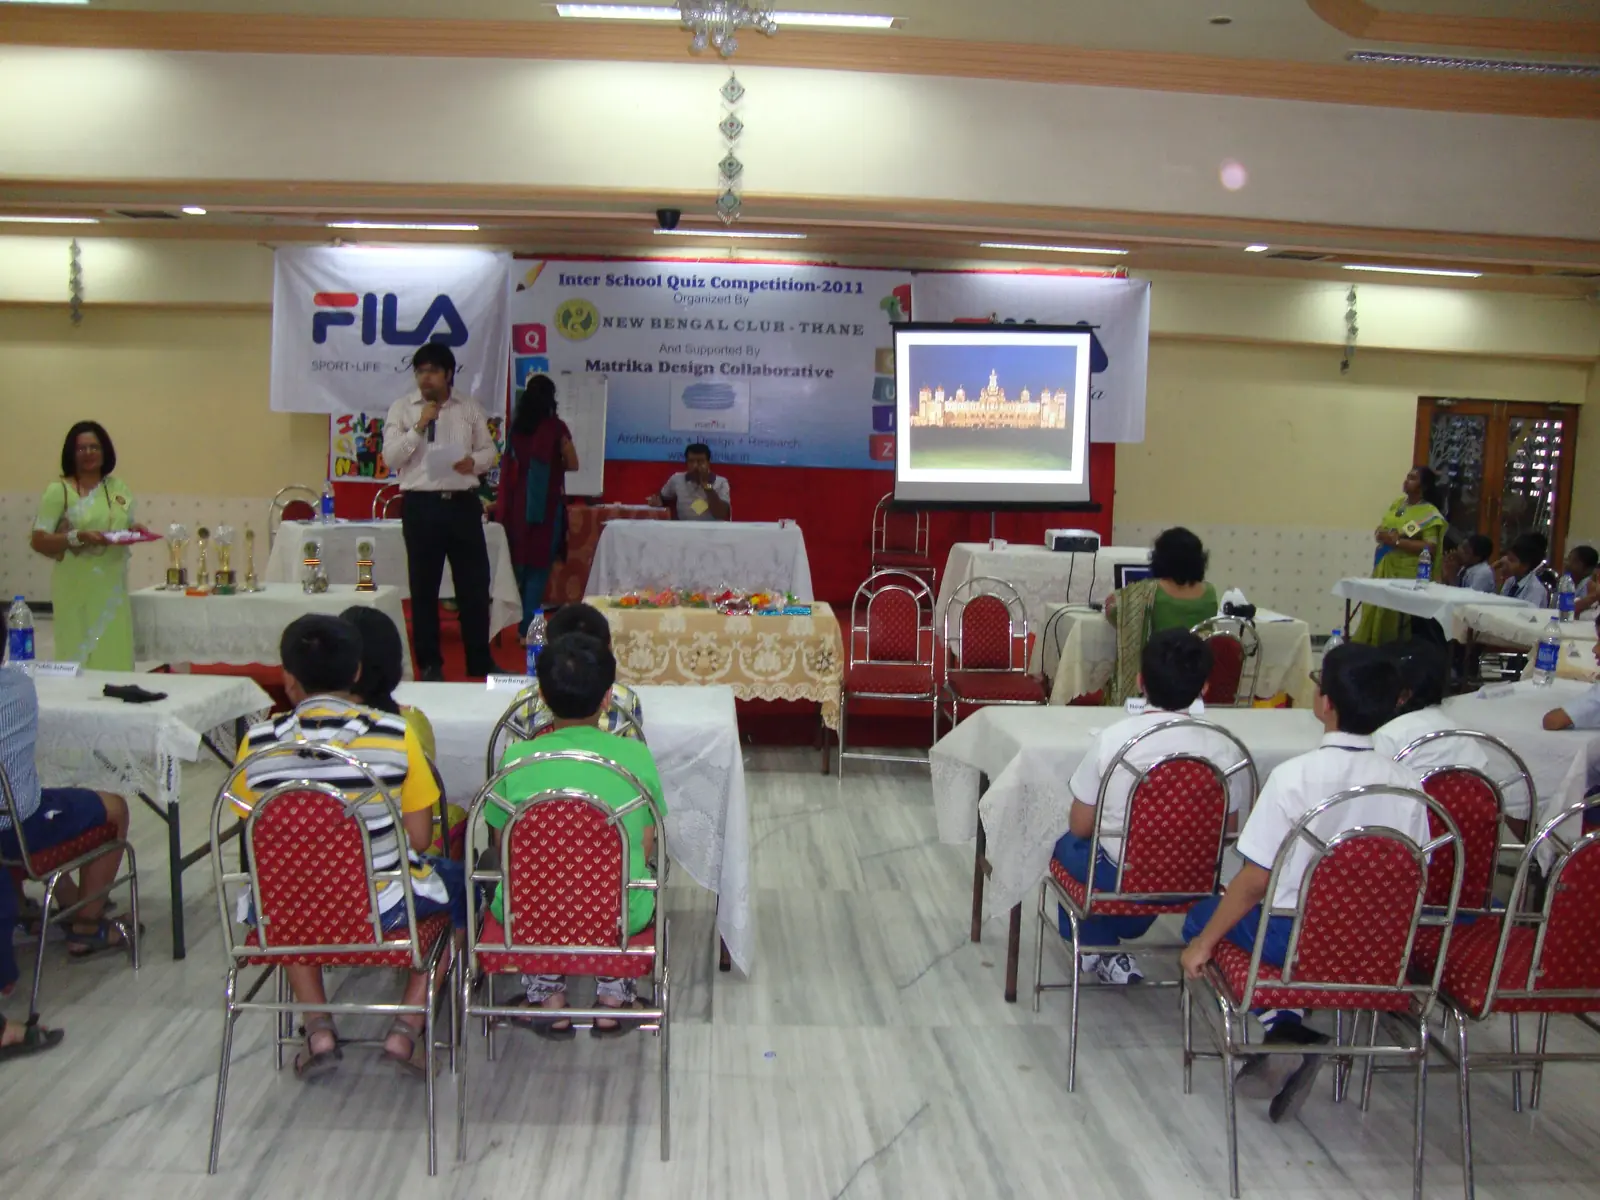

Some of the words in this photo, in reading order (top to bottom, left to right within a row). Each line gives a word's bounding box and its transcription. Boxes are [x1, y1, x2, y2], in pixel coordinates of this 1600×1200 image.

[559, 274, 600, 286] Inter
[605, 274, 661, 287] School
[667, 275, 705, 289] Quiz
[710, 276, 864, 294] Competition-2011
[673, 293, 730, 306] Organized
[735, 295, 749, 307] By
[312, 292, 469, 347] FILA
[602, 316, 645, 328] NEW
[650, 317, 729, 331] BENGAL
[733, 319, 785, 333] CLUB
[799, 322, 865, 336] THANE
[659, 344, 681, 354] And
[685, 344, 742, 357] Supported
[746, 347, 760, 359] By
[585, 359, 653, 373] Matrika
[658, 361, 714, 376] Design
[719, 362, 835, 379] Collaborative
